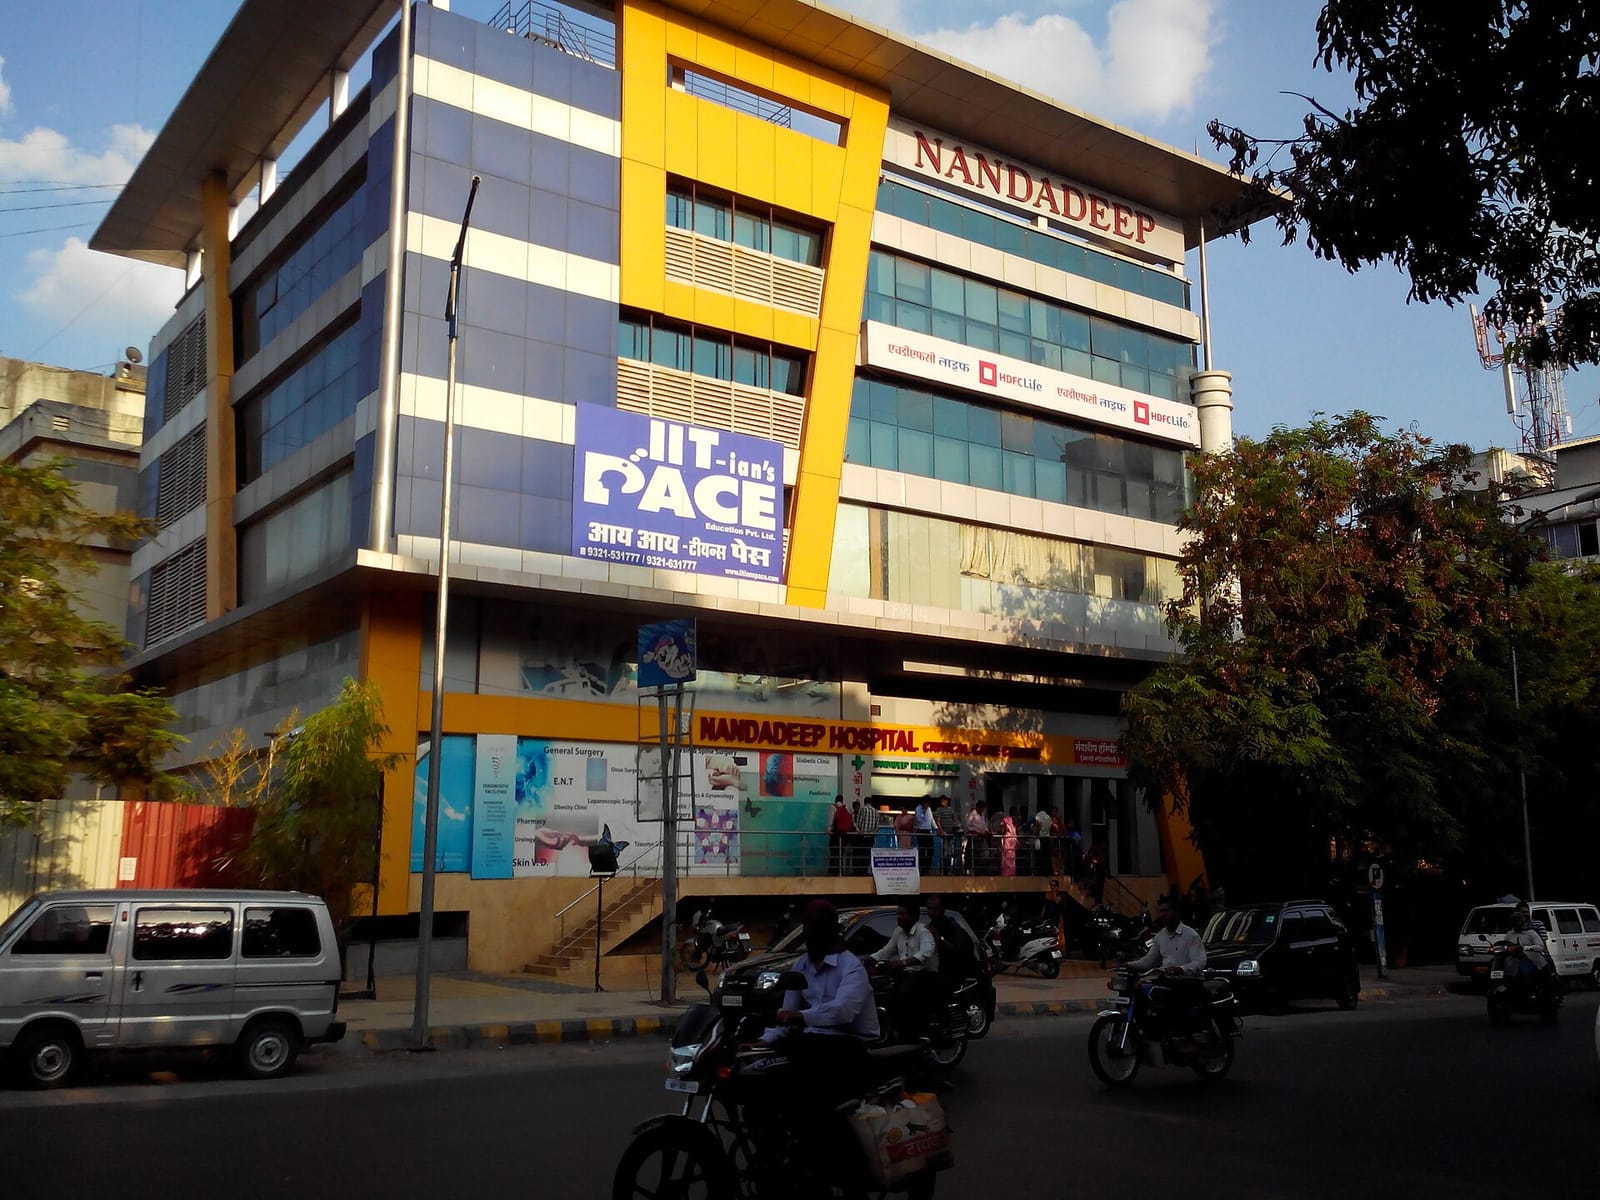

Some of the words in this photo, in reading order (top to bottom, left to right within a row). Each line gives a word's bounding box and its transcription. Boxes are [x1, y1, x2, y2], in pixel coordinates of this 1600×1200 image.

[914, 130, 1156, 244] NANDADEEP
[888, 343, 936, 364] एचडीएफसी
[938, 356, 970, 373] लाइफ
[1056, 387, 1098, 405] एचडीएफसी
[1099, 398, 1127, 412] लाइफ
[583, 450, 776, 531] PACE
[705, 522, 744, 536] Education
[745, 528, 760, 539] Pvt.
[761, 531, 776, 541] Ltd.
[588, 521, 633, 547] आय
[637, 529, 680, 554] आय
[730, 538, 771, 568] पेस
[587, 546, 641, 564] 9321-531777
[646, 556, 697, 570] 9321-631777
[700, 716, 826, 747] NANDADEEP
[829, 725, 919, 753] HOSPITAL
[543, 746, 574, 756] General
[575, 747, 605, 758] Surgery
[553, 777, 574, 786] E.N.T
[516, 818, 547, 827] Pharmacy
[512, 858, 531, 867] Skin
